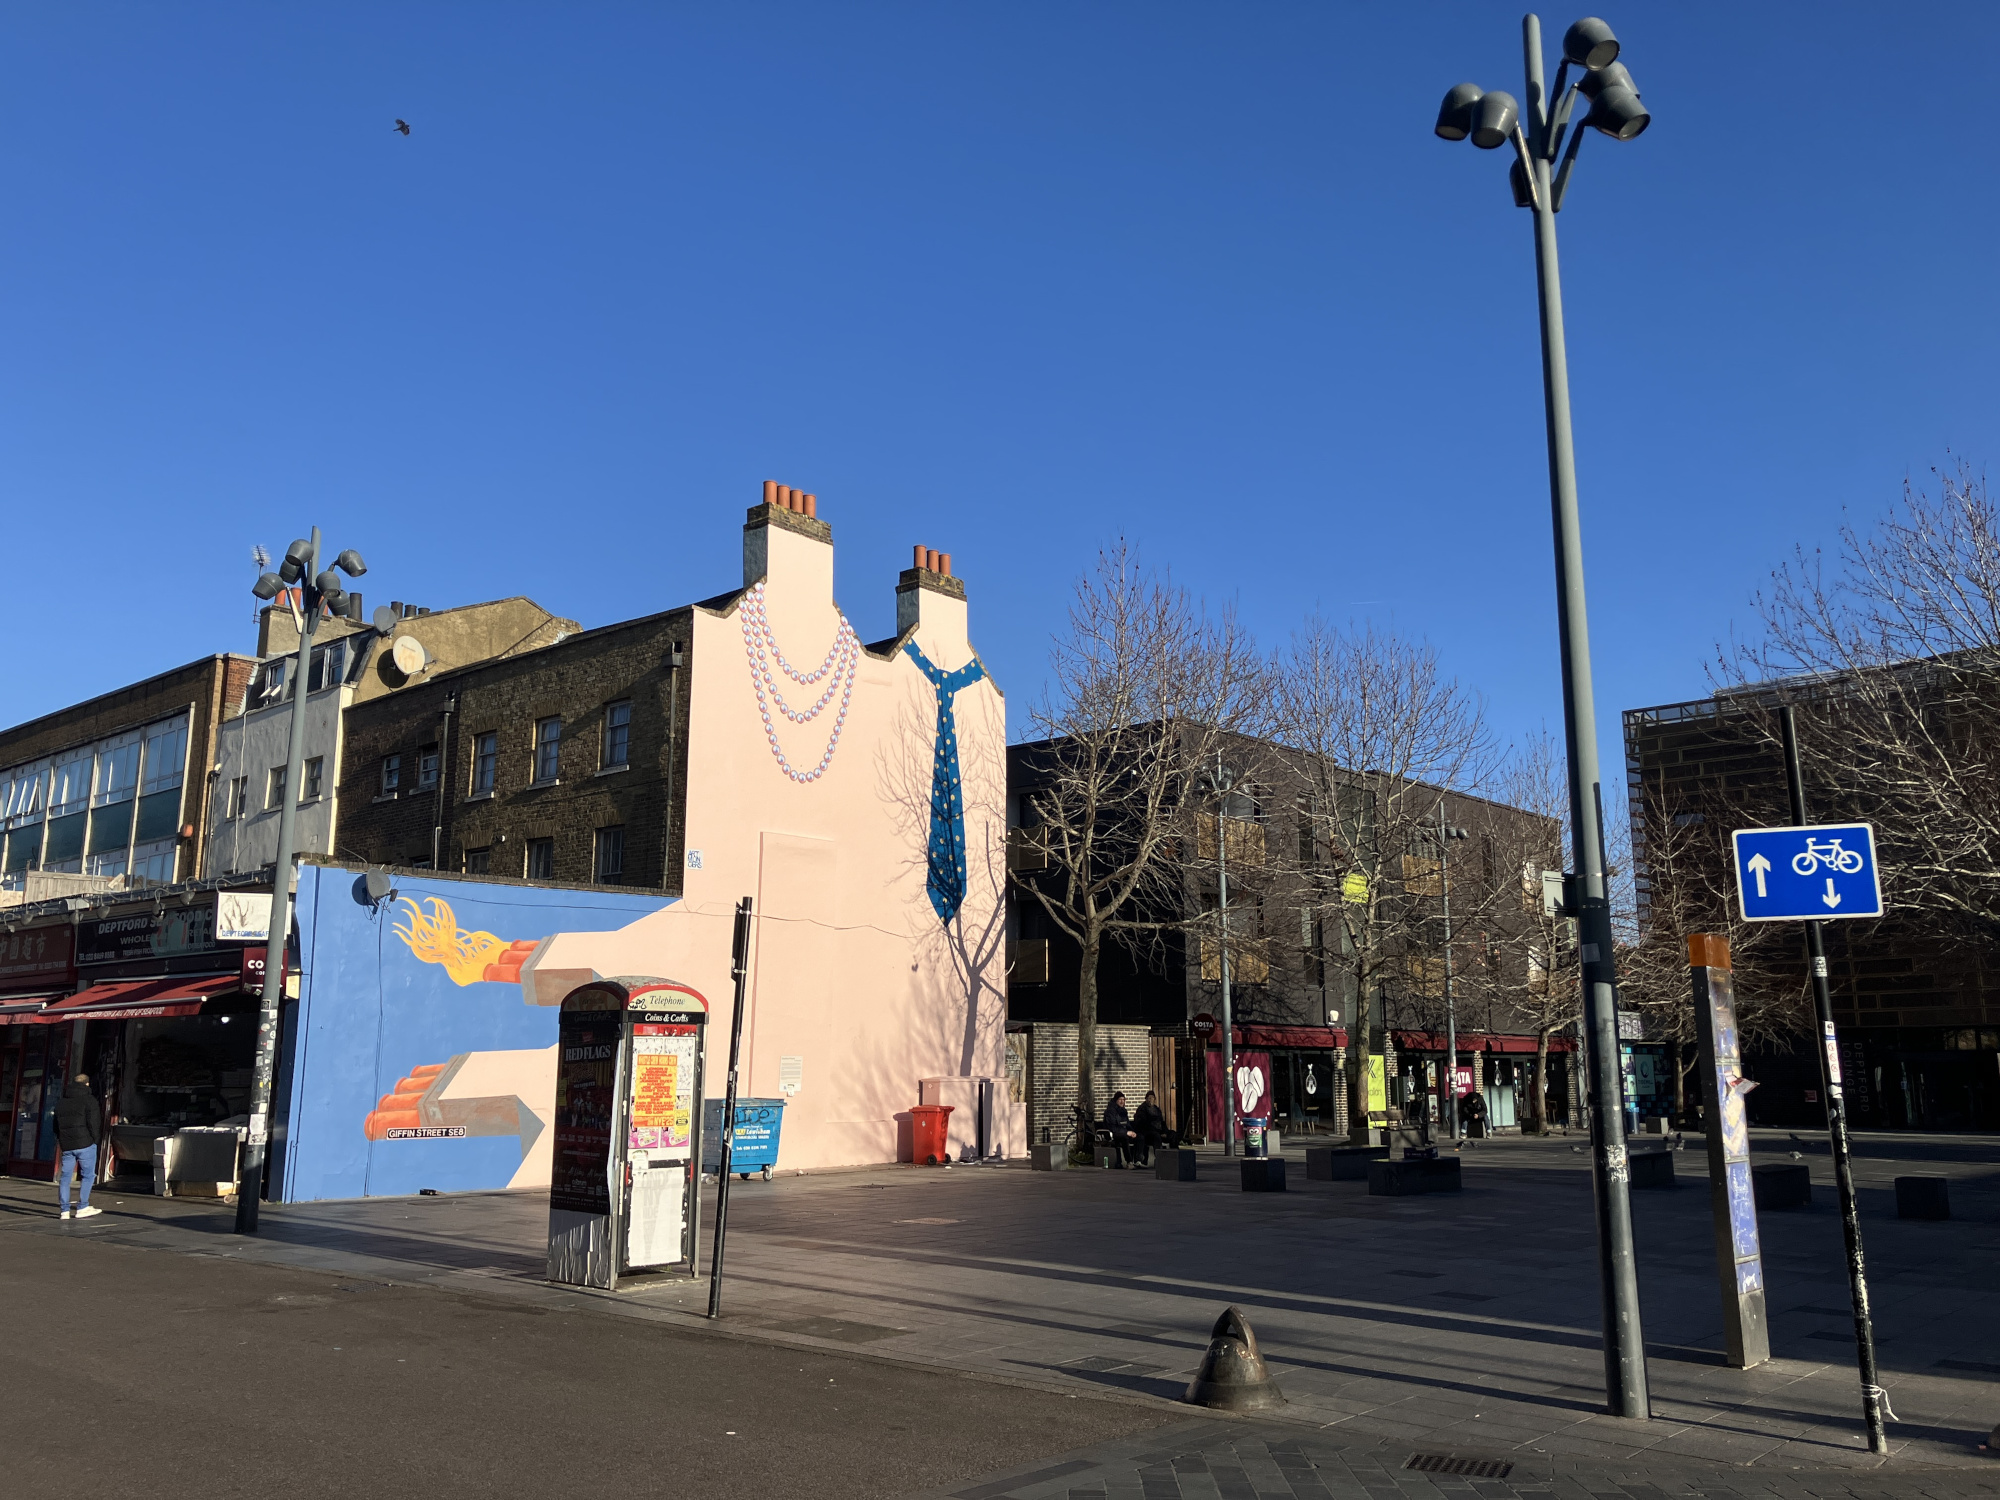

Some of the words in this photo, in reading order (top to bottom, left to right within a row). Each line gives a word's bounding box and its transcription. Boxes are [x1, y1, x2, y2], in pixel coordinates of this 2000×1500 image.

[98, 919, 148, 935] DEPTFORD
[650, 995, 685, 1007] Telephone
[645, 1013, 662, 1022] Coins
[663, 1014, 669, 1022] &
[565, 1047, 583, 1062] RED
[584, 1044, 611, 1061] FLAGS
[1841, 1042, 1855, 1095] LOUNGE
[1853, 1043, 1869, 1112] DEPTFORD
[389, 1129, 415, 1138] GIFFIN
[416, 1128, 447, 1137] STREET
